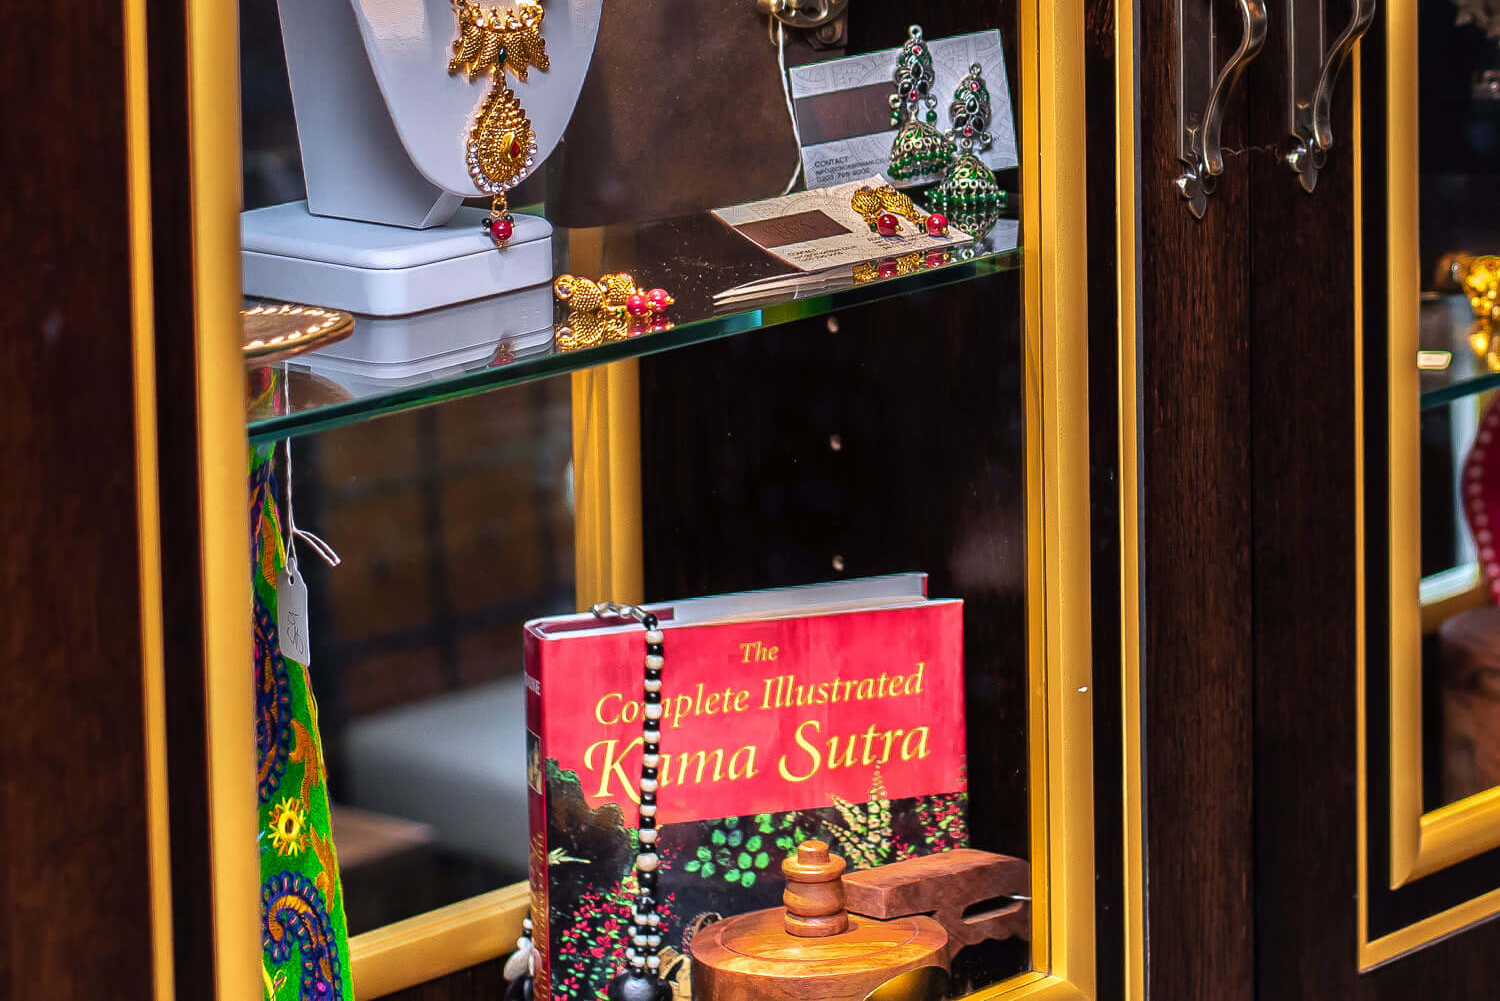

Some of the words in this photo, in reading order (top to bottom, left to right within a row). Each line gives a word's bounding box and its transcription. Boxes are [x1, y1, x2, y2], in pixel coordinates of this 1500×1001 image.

[740, 641, 779, 663] The
[759, 662, 926, 710] Illustrated
[778, 720, 931, 783] Sutra
